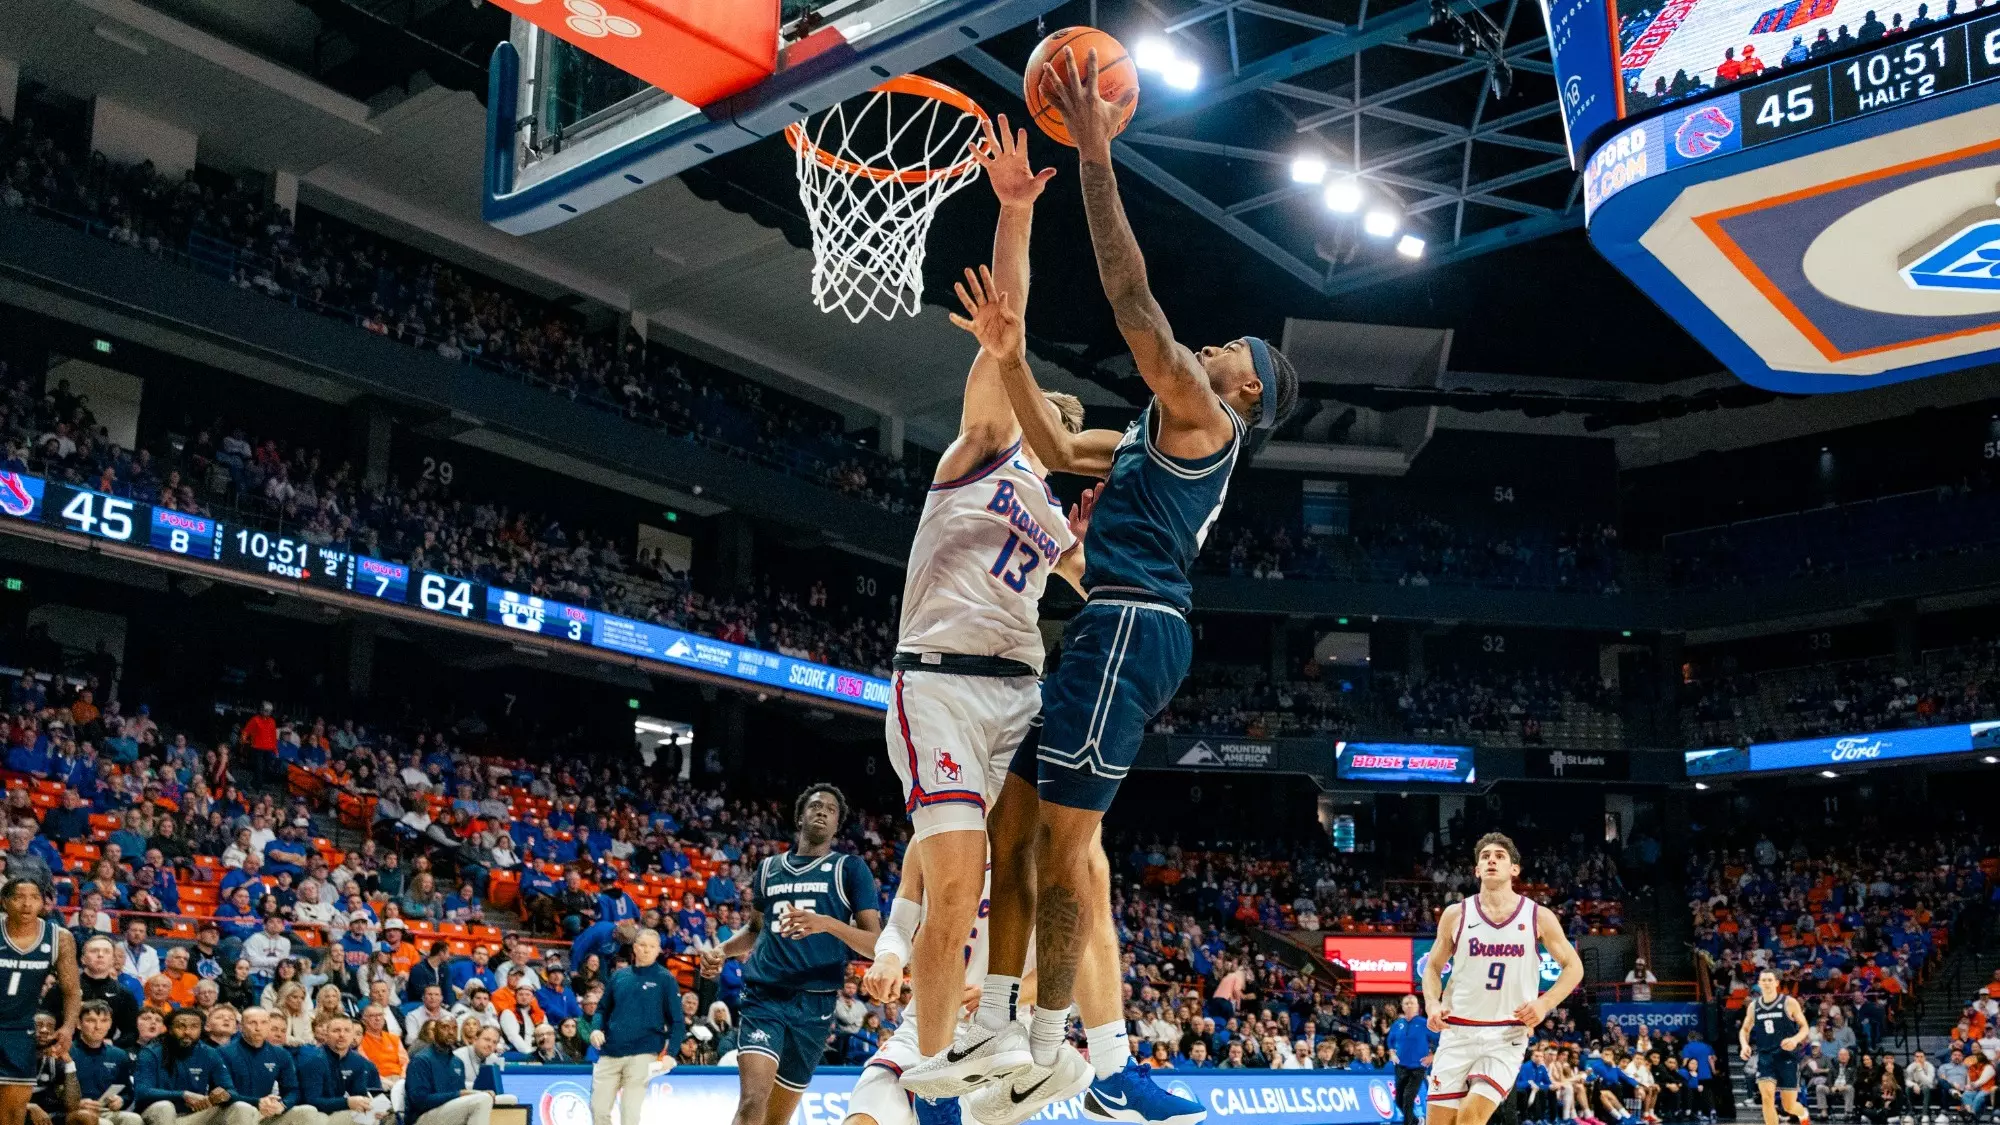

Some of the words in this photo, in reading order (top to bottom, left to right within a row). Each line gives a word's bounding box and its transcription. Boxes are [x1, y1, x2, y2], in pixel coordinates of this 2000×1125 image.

[1847, 36, 1946, 92] 10:51
[1858, 80, 1912, 110] HALF
[1918, 73, 1936, 96] 2
[1755, 84, 1814, 128] 45
[422, 456, 453, 485] 29
[61, 491, 133, 541] 45
[159, 512, 206, 533] FOULS
[170, 530, 190, 553] 8
[236, 529, 308, 568] 10:51
[319, 548, 346, 563] HALF
[989, 530, 1039, 594] 13
[268, 561, 303, 579] POSS
[324, 560, 338, 577] 2
[363, 560, 402, 578] FOULS
[375, 576, 390, 598] 7
[420, 574, 474, 618] 64
[856, 575, 877, 597] 30
[499, 599, 545, 623] STATE
[567, 620, 582, 641] 3
[1482, 635, 1505, 652] 32
[789, 664, 827, 691] SCORE
[826, 672, 836, 693] A
[836, 675, 864, 698] $150
[504, 692, 516, 716] 7
[1220, 744, 1271, 755] MOUNTAIN
[1223, 753, 1268, 763] AMERICA
[1831, 737, 1881, 761] Ford
[1352, 755, 1405, 768] BOISE
[1408, 757, 1459, 770] STATE
[767, 883, 793, 897] UTAH
[793, 882, 829, 893] STATE
[1469, 937, 1525, 958] Broncos
[7, 971, 22, 996] 1
[1485, 961, 1506, 991] 9
[1618, 1014, 1645, 1027] CBS
[1647, 1014, 1699, 1028] SPORTS
[1210, 1086, 1361, 1117] CALLBILLS.COM
